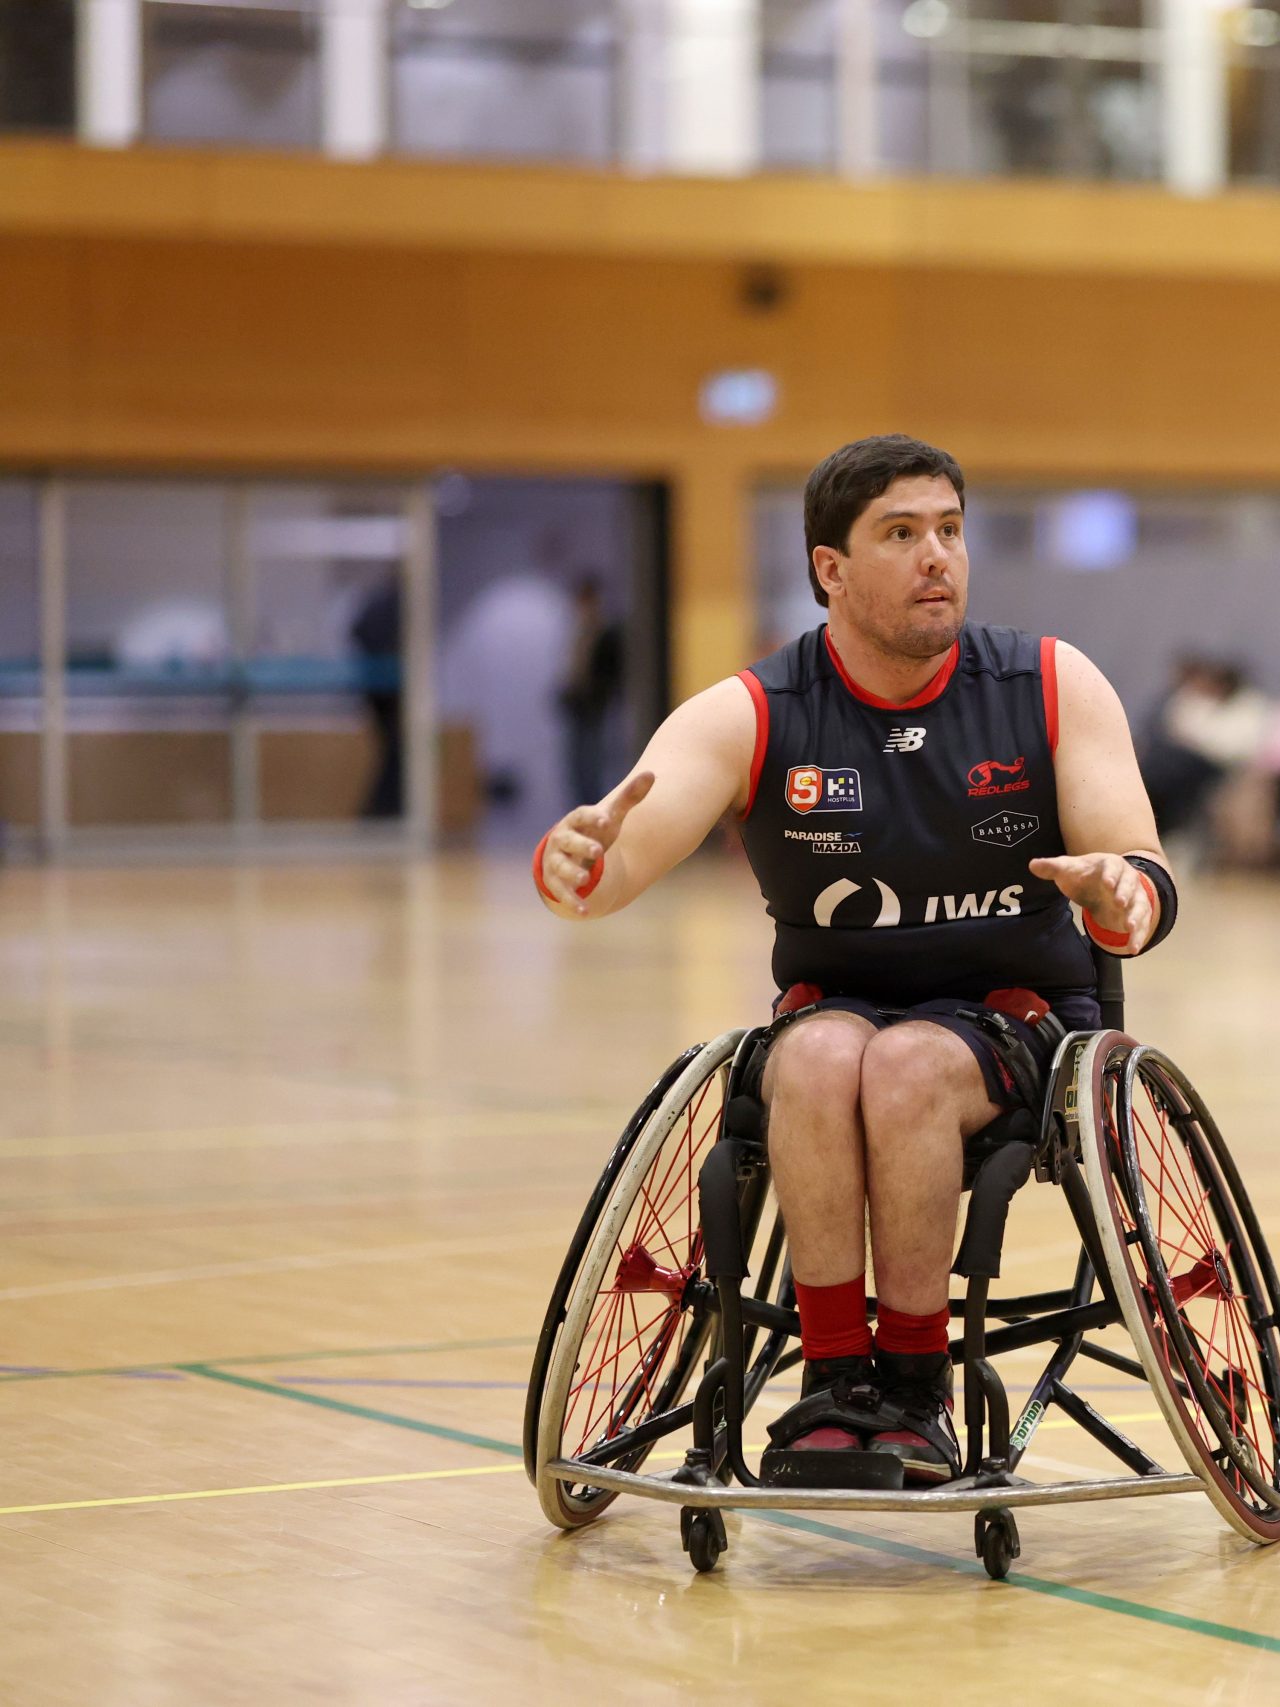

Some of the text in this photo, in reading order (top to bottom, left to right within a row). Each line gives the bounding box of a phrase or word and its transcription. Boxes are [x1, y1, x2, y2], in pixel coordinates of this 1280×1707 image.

[883, 727, 927, 753] NB
[967, 780, 1030, 797] REDLEGS
[784, 829, 842, 841] PARADISE
[979, 821, 1033, 836] BAROSSA
[813, 842, 860, 853] MAZDA
